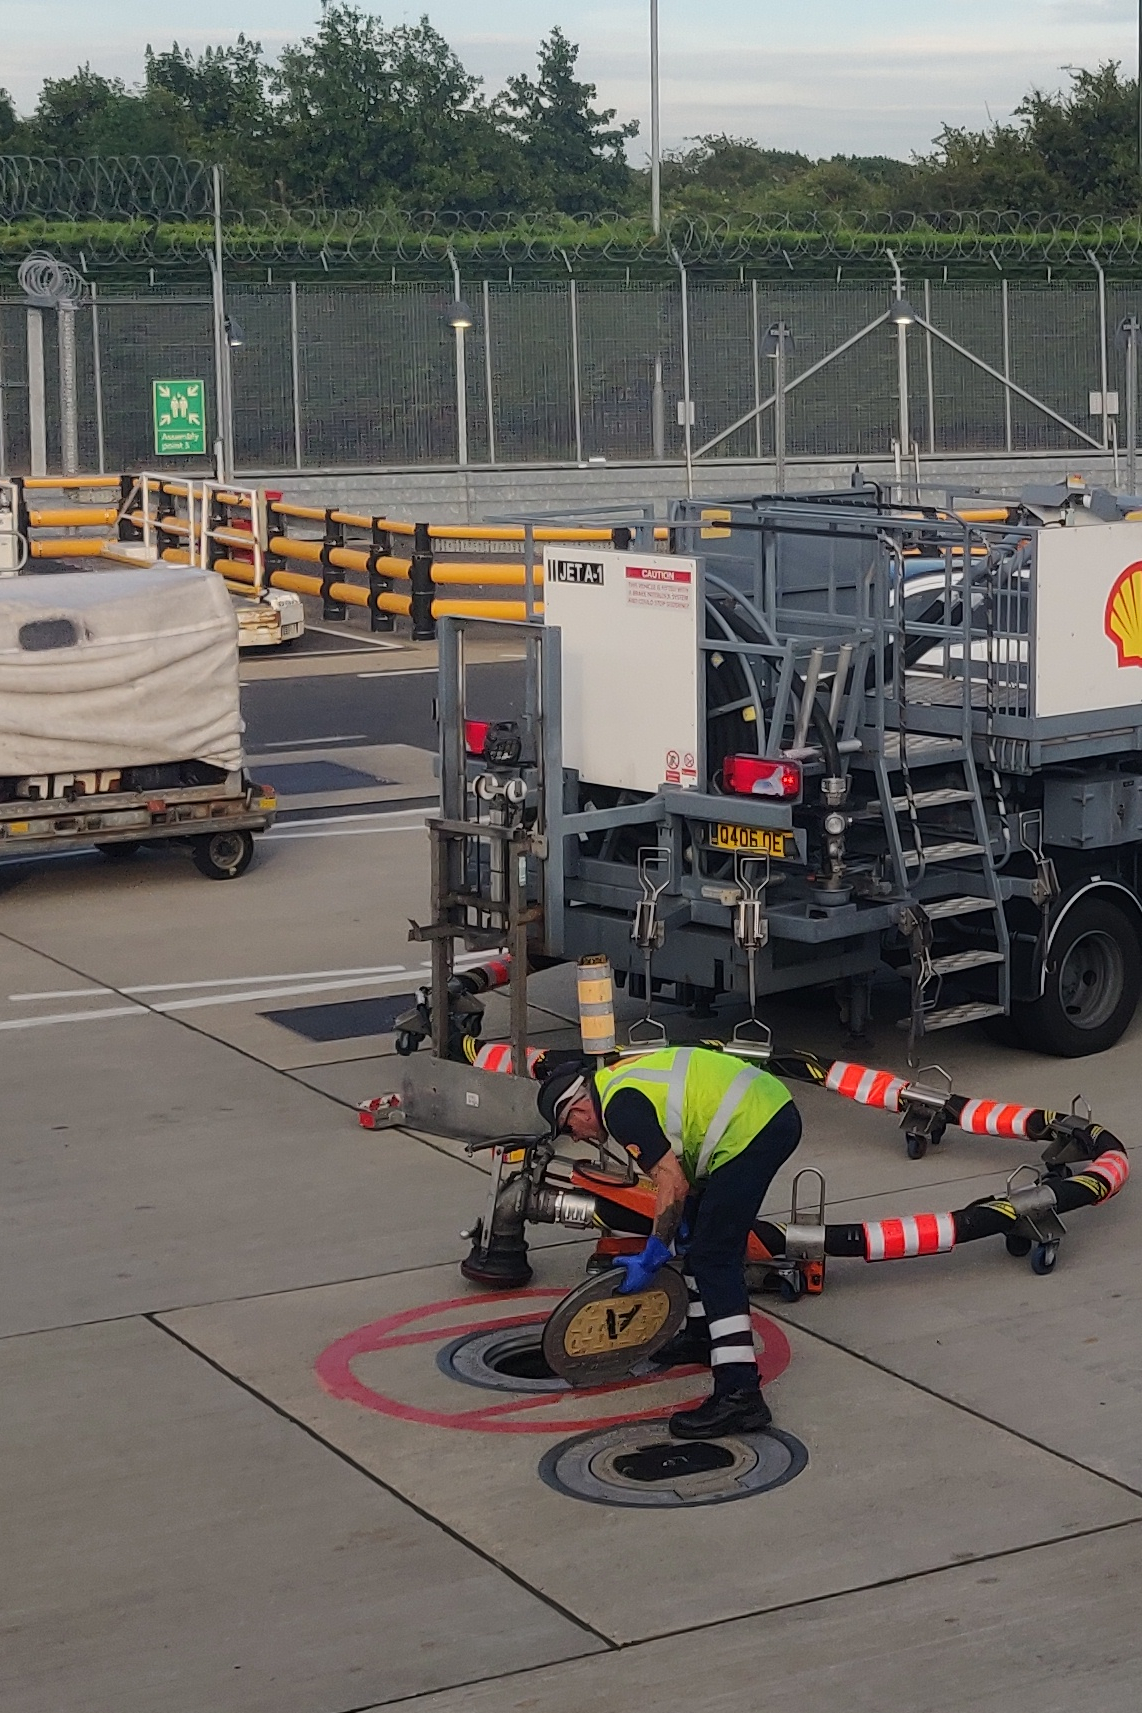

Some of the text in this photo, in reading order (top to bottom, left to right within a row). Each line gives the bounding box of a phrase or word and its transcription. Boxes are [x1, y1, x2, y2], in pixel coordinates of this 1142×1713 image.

[161, 432, 199, 442] Assembly
[161, 443, 183, 451] point
[559, 562, 603, 584] JET A-1
[641, 569, 675, 581] CAUTION
[721, 825, 758, 848] Q406
